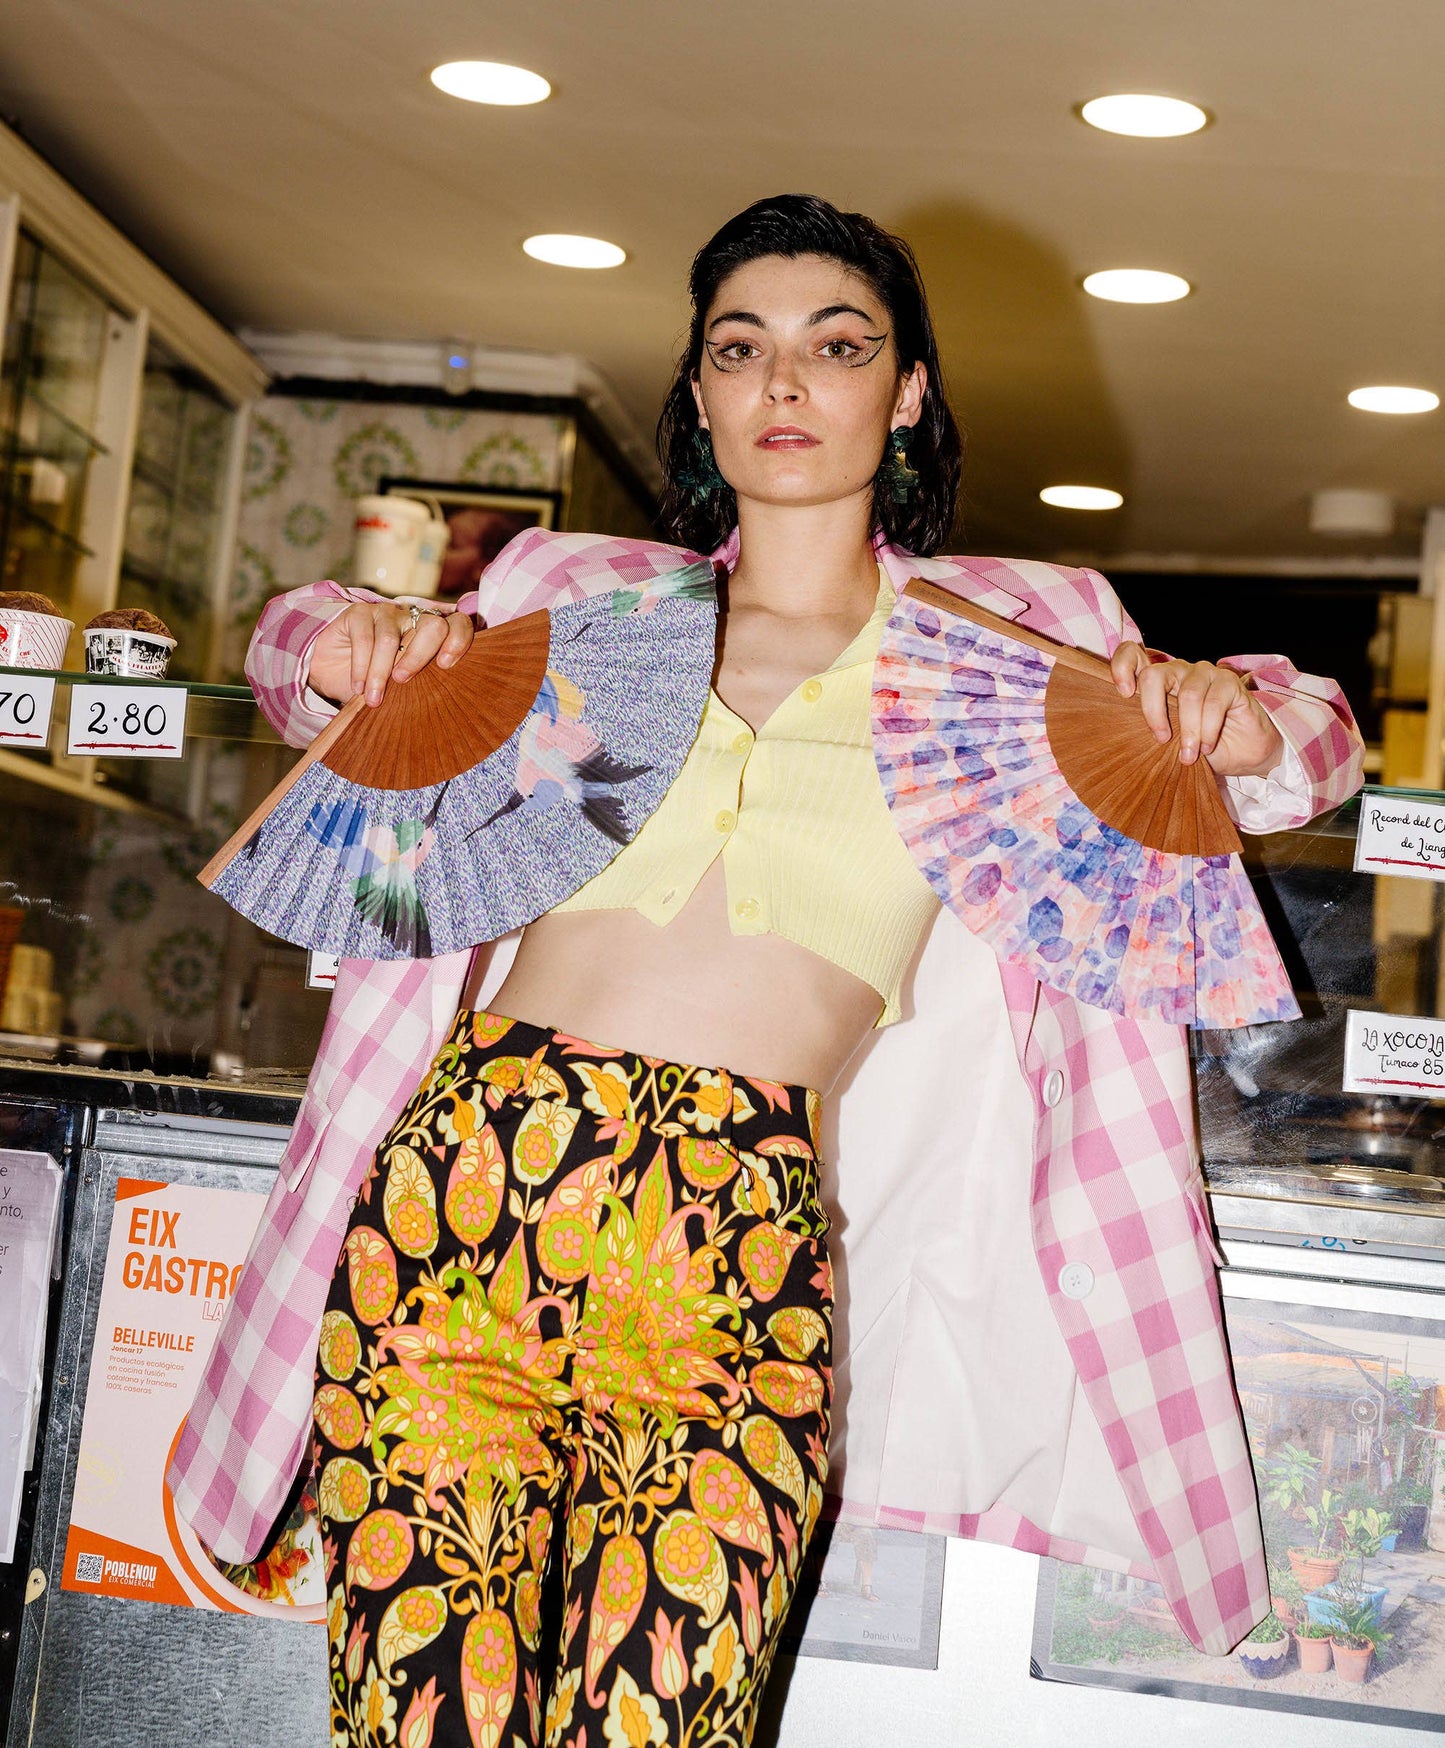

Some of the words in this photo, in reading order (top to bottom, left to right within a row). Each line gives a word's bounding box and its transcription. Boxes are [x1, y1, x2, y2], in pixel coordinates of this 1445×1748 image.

[1370, 809, 1411, 832] Record
[1413, 814, 1431, 828] del
[1434, 818, 1445, 833] C
[1401, 837, 1414, 849] de
[1361, 1028, 1378, 1051] LA
[1383, 1031, 1445, 1057] XOCOLA
[1378, 1054, 1419, 1073] Tumaco
[1422, 1057, 1443, 1076] 85
[128, 1207, 181, 1249] EIX
[113, 1326, 195, 1352] BELLEVILLE
[109, 1355, 144, 1366] Productos
[146, 1360, 185, 1371] ecológicos
[118, 1366, 143, 1374] cocina
[144, 1369, 166, 1378] fusión
[105, 1382, 122, 1390] 100%
[106, 1373, 139, 1383] catalana
[146, 1379, 178, 1388] francesa
[104, 1560, 157, 1582] POBLENOU
[120, 1577, 155, 1588] COMERCIAL
[862, 1629, 890, 1641] Daniel
